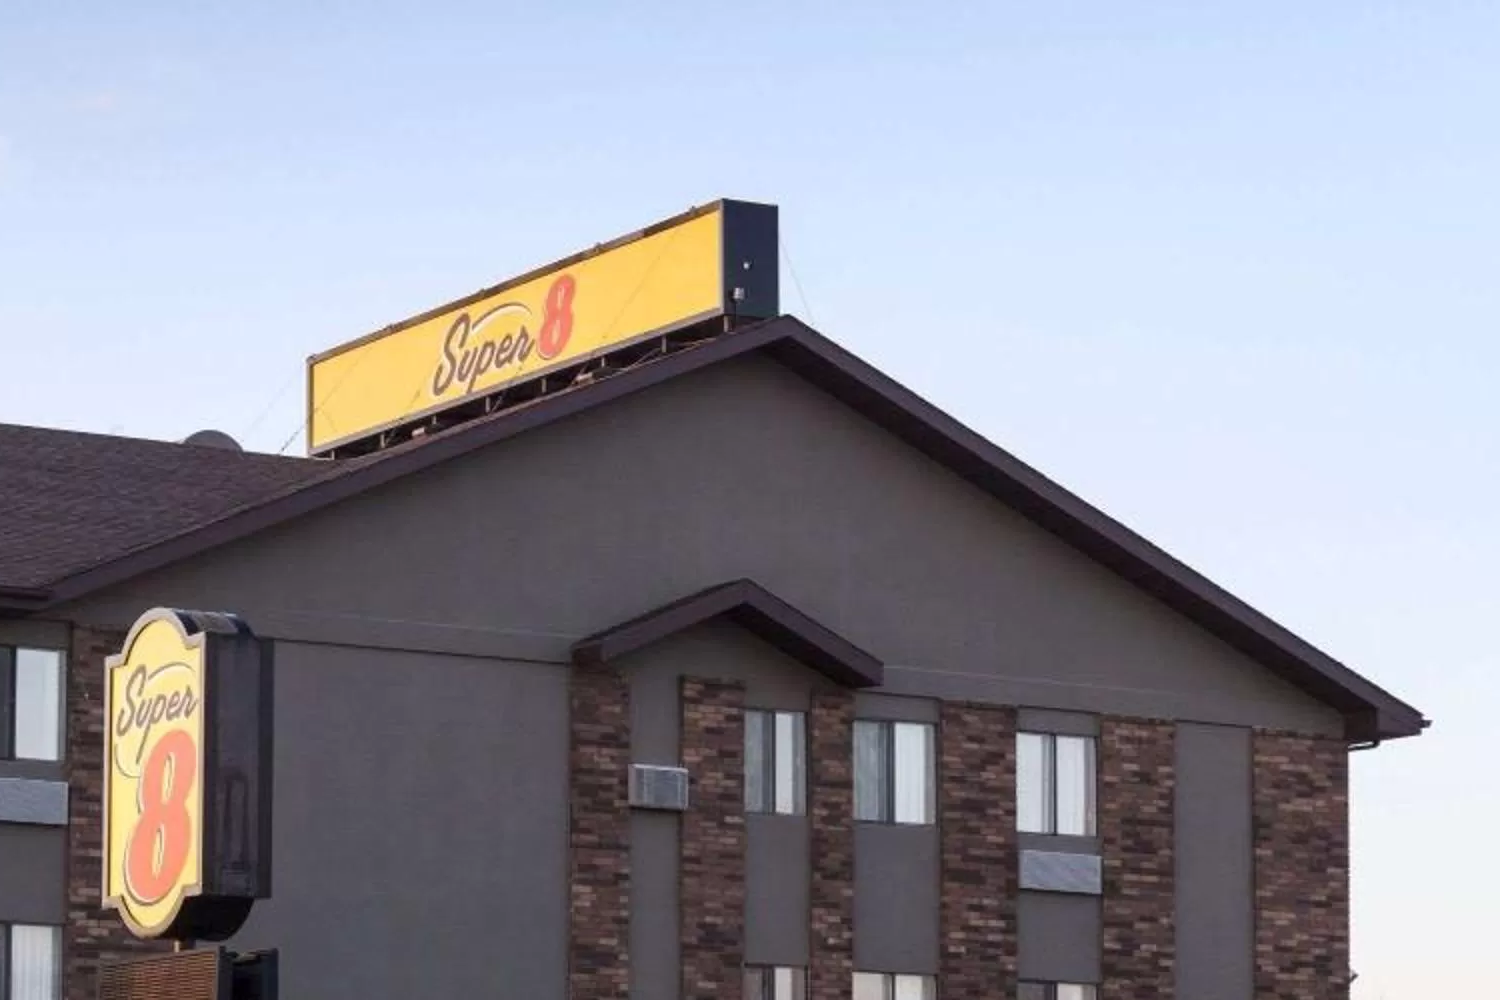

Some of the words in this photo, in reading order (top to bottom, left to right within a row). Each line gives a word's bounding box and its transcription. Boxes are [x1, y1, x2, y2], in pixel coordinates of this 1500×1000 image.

[433, 312, 535, 396] Super
[537, 274, 576, 360] 8
[116, 664, 198, 765] Super
[125, 729, 198, 905] 8
